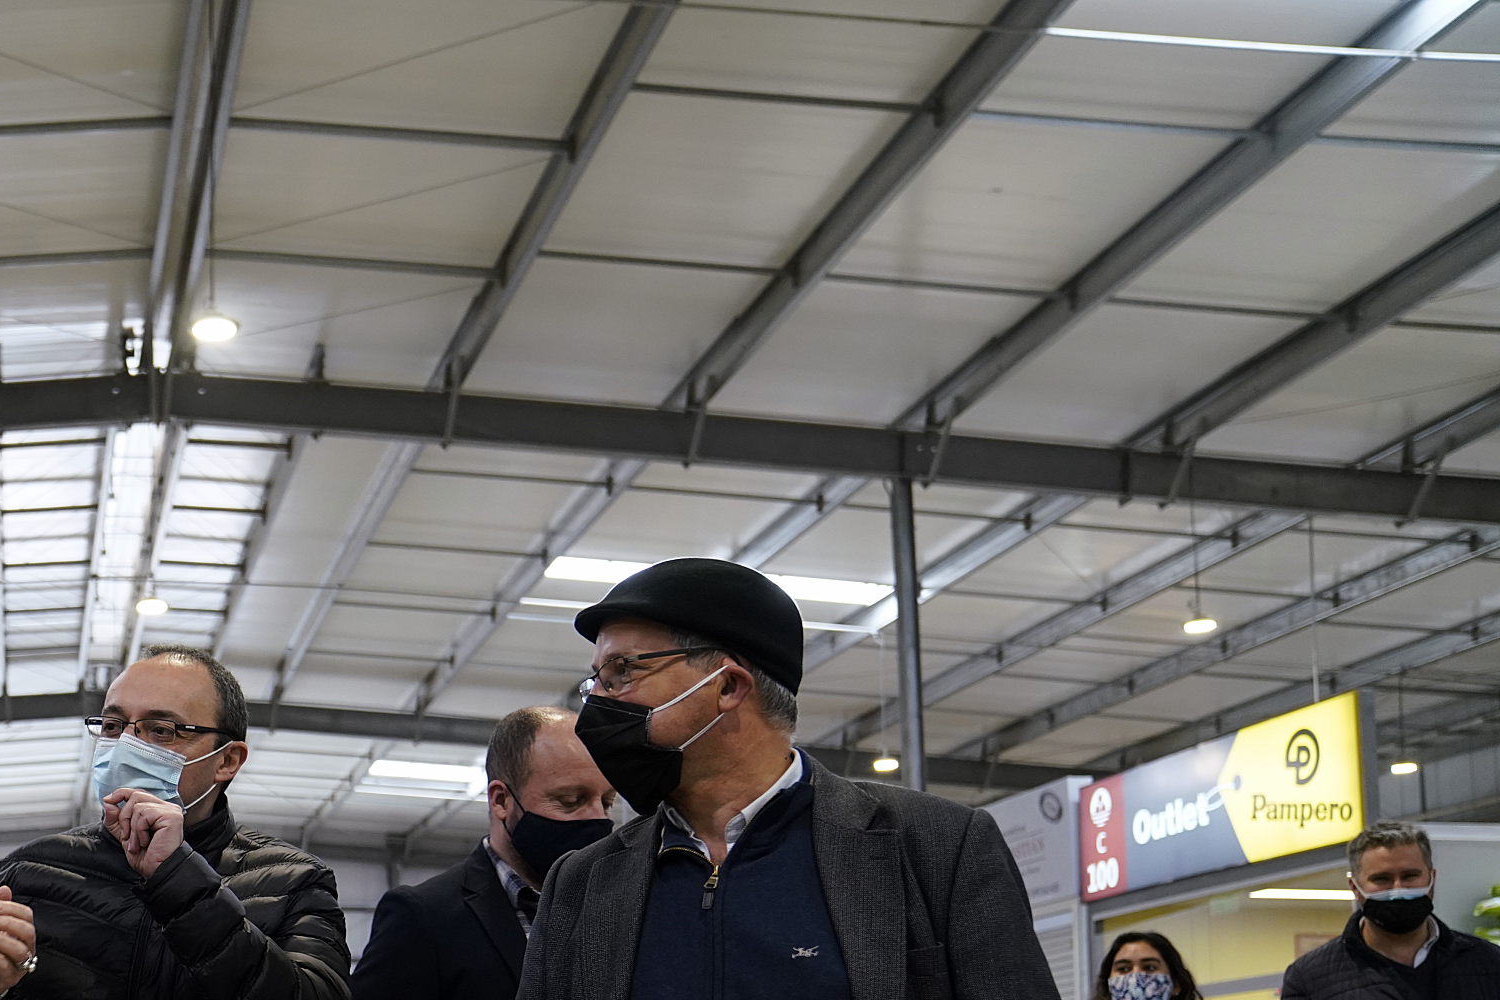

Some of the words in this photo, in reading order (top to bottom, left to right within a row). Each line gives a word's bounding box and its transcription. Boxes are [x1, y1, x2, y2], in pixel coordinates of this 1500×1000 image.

[1131, 791, 1211, 846] Outlet
[1252, 793, 1353, 828] Pampero
[1095, 831, 1109, 854] C
[1086, 857, 1120, 894] 100
